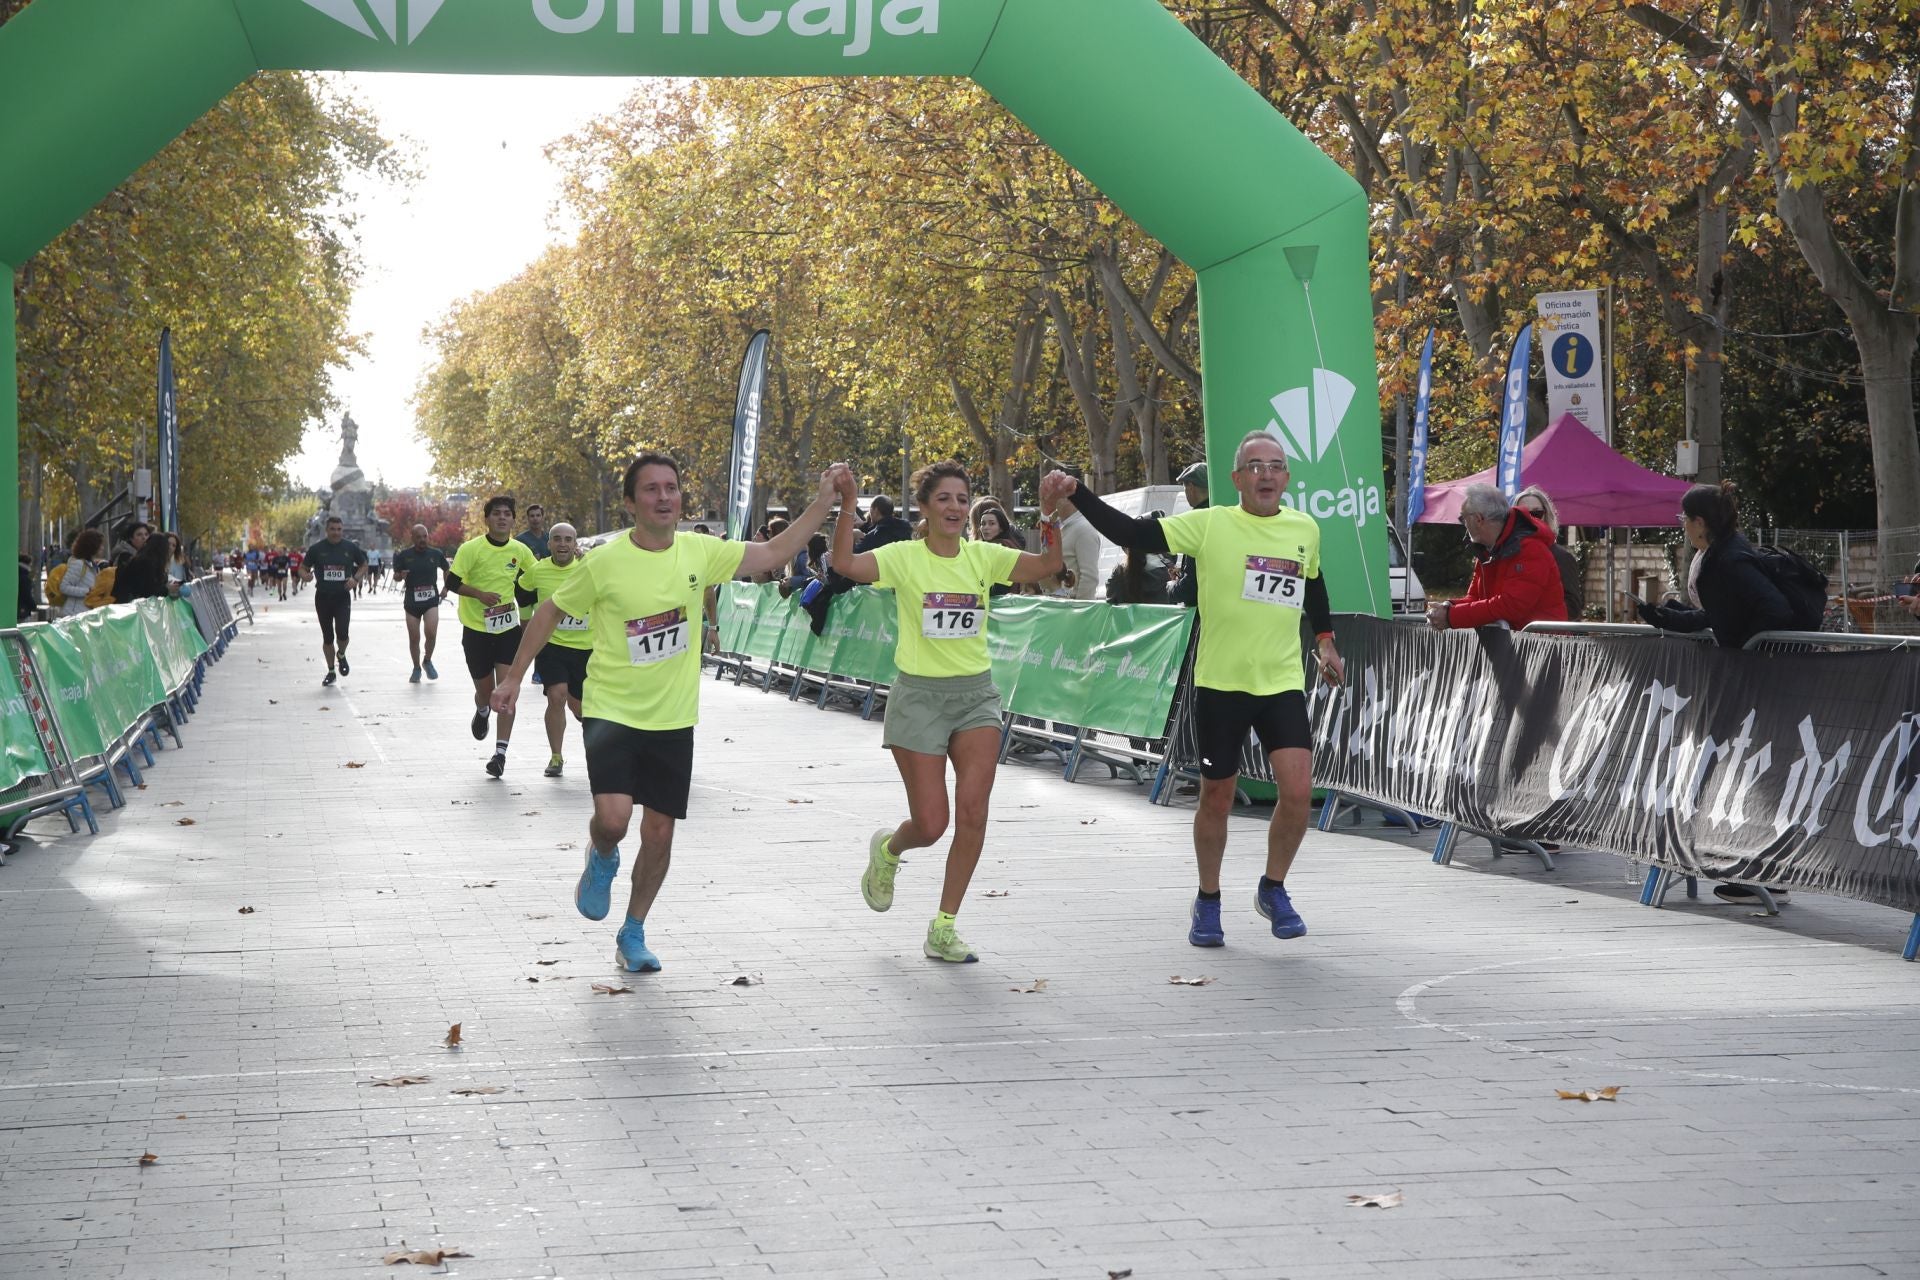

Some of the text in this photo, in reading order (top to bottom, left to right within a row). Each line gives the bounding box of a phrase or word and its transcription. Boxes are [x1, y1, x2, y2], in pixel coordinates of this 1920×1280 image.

[1545, 301, 1571, 309] Oficina
[737, 391, 761, 509] Unicaja
[1280, 477, 1380, 528] icaja
[1255, 574, 1296, 597] 175
[490, 613, 512, 628] 770
[933, 611, 975, 629] 176
[639, 626, 680, 654] 177
[1619, 678, 1772, 833] Norte
[1772, 714, 1851, 839] de
